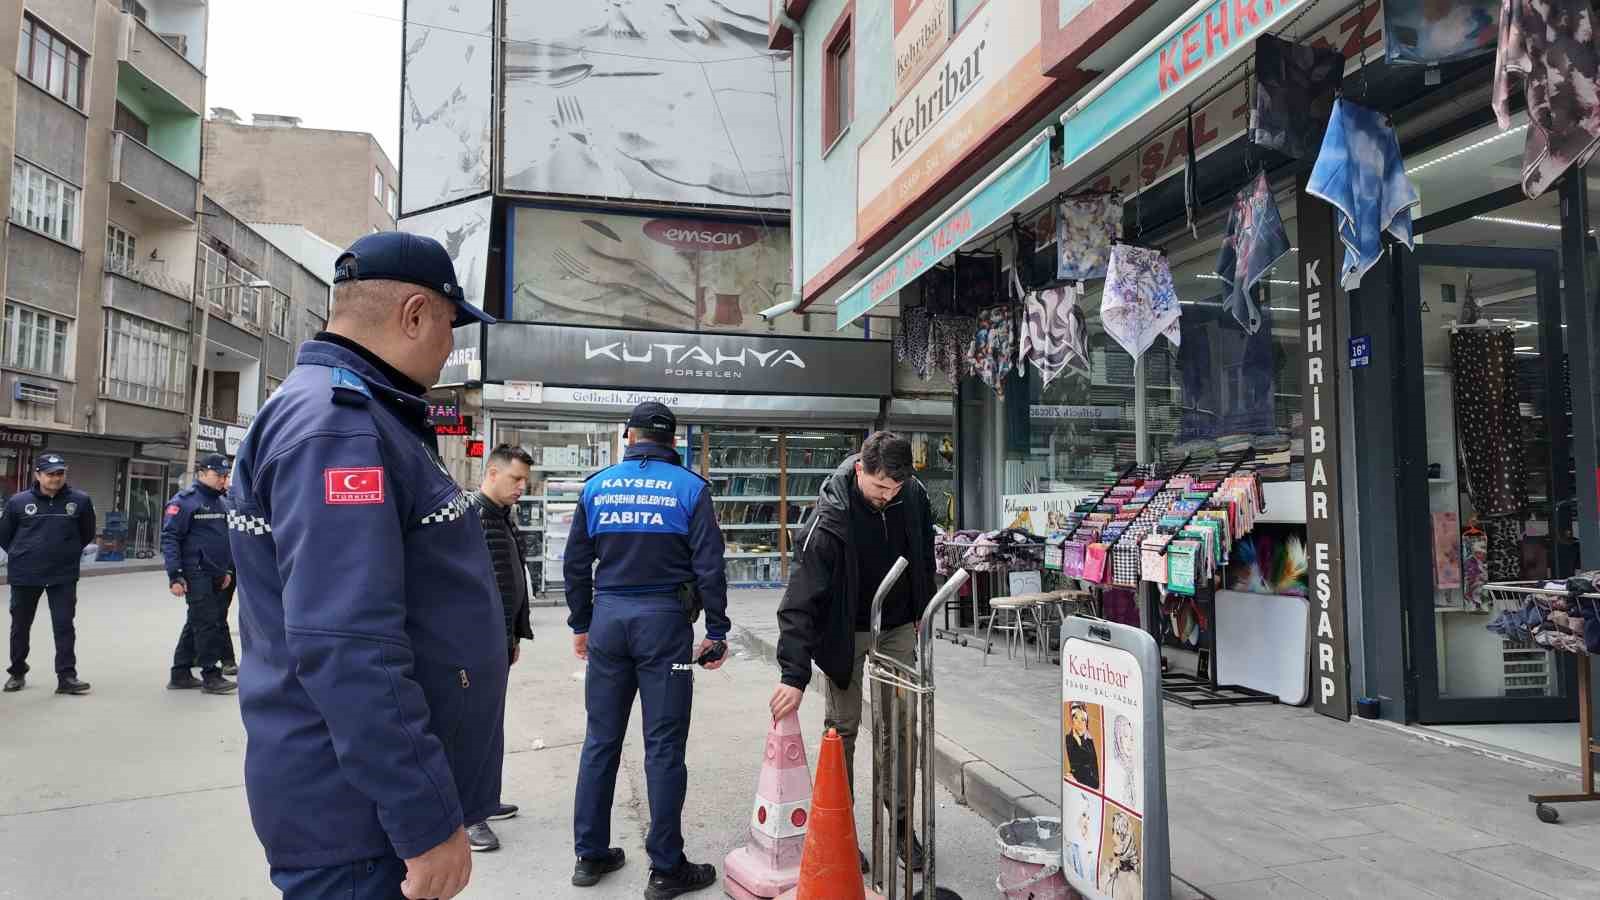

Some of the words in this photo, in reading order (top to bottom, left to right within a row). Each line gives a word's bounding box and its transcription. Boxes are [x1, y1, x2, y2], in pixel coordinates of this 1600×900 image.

[896, 10, 945, 79] Kehribar
[889, 39, 986, 164] Kehribar
[663, 228, 742, 245] emsan
[664, 368, 742, 379] PORSELEN
[1306, 259, 1329, 519] KEHRİBAR
[599, 511, 664, 525] ZABITA
[1315, 543, 1336, 705] EŞARP
[1068, 654, 1129, 689] Kehribar
